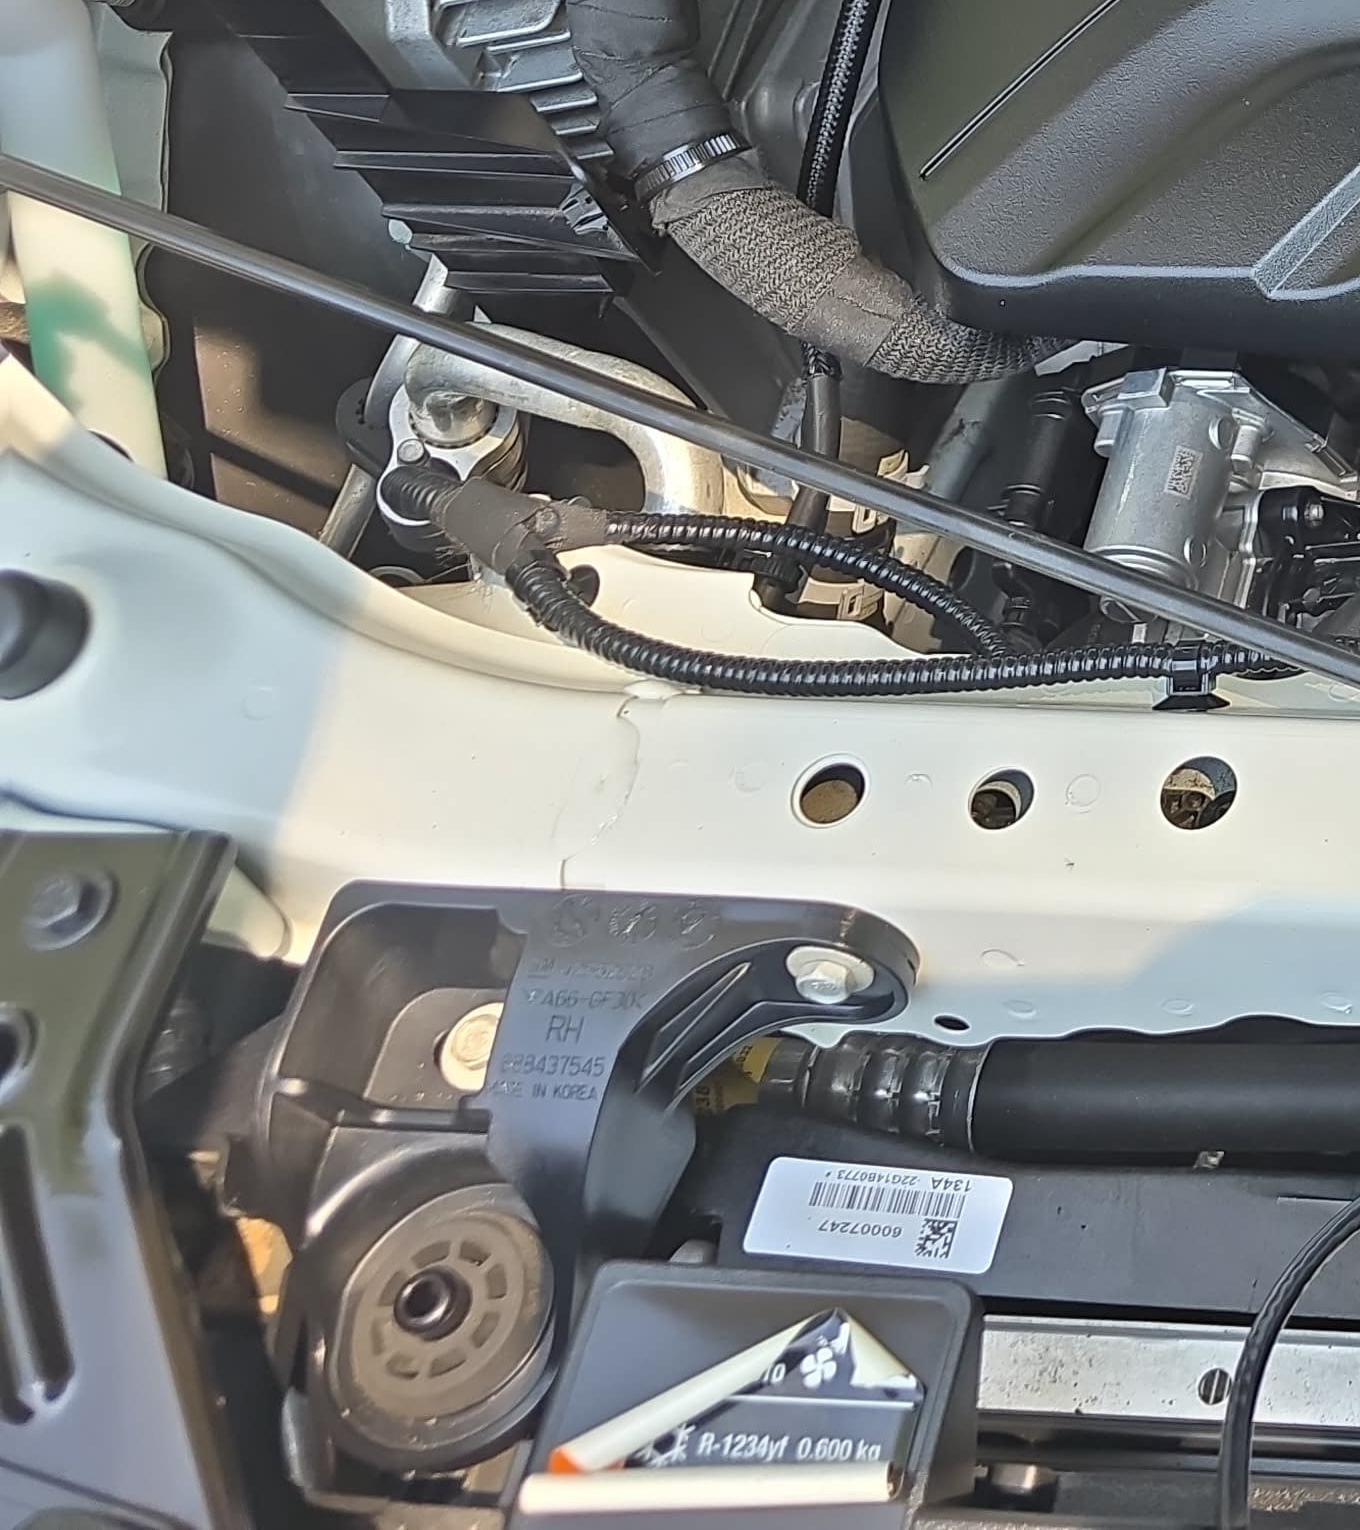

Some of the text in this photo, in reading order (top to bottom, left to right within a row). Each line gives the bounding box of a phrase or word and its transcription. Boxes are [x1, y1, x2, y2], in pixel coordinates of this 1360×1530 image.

[545, 1014, 585, 1043] RH
[532, 1084, 547, 1099] IN
[553, 1085, 599, 1101] KOREA
[930, 1176, 972, 1192] 134A
[818, 1219, 903, 1238] 60007247
[698, 1433, 788, 1462] R-1234yf
[797, 1437, 853, 1462] 0.600
